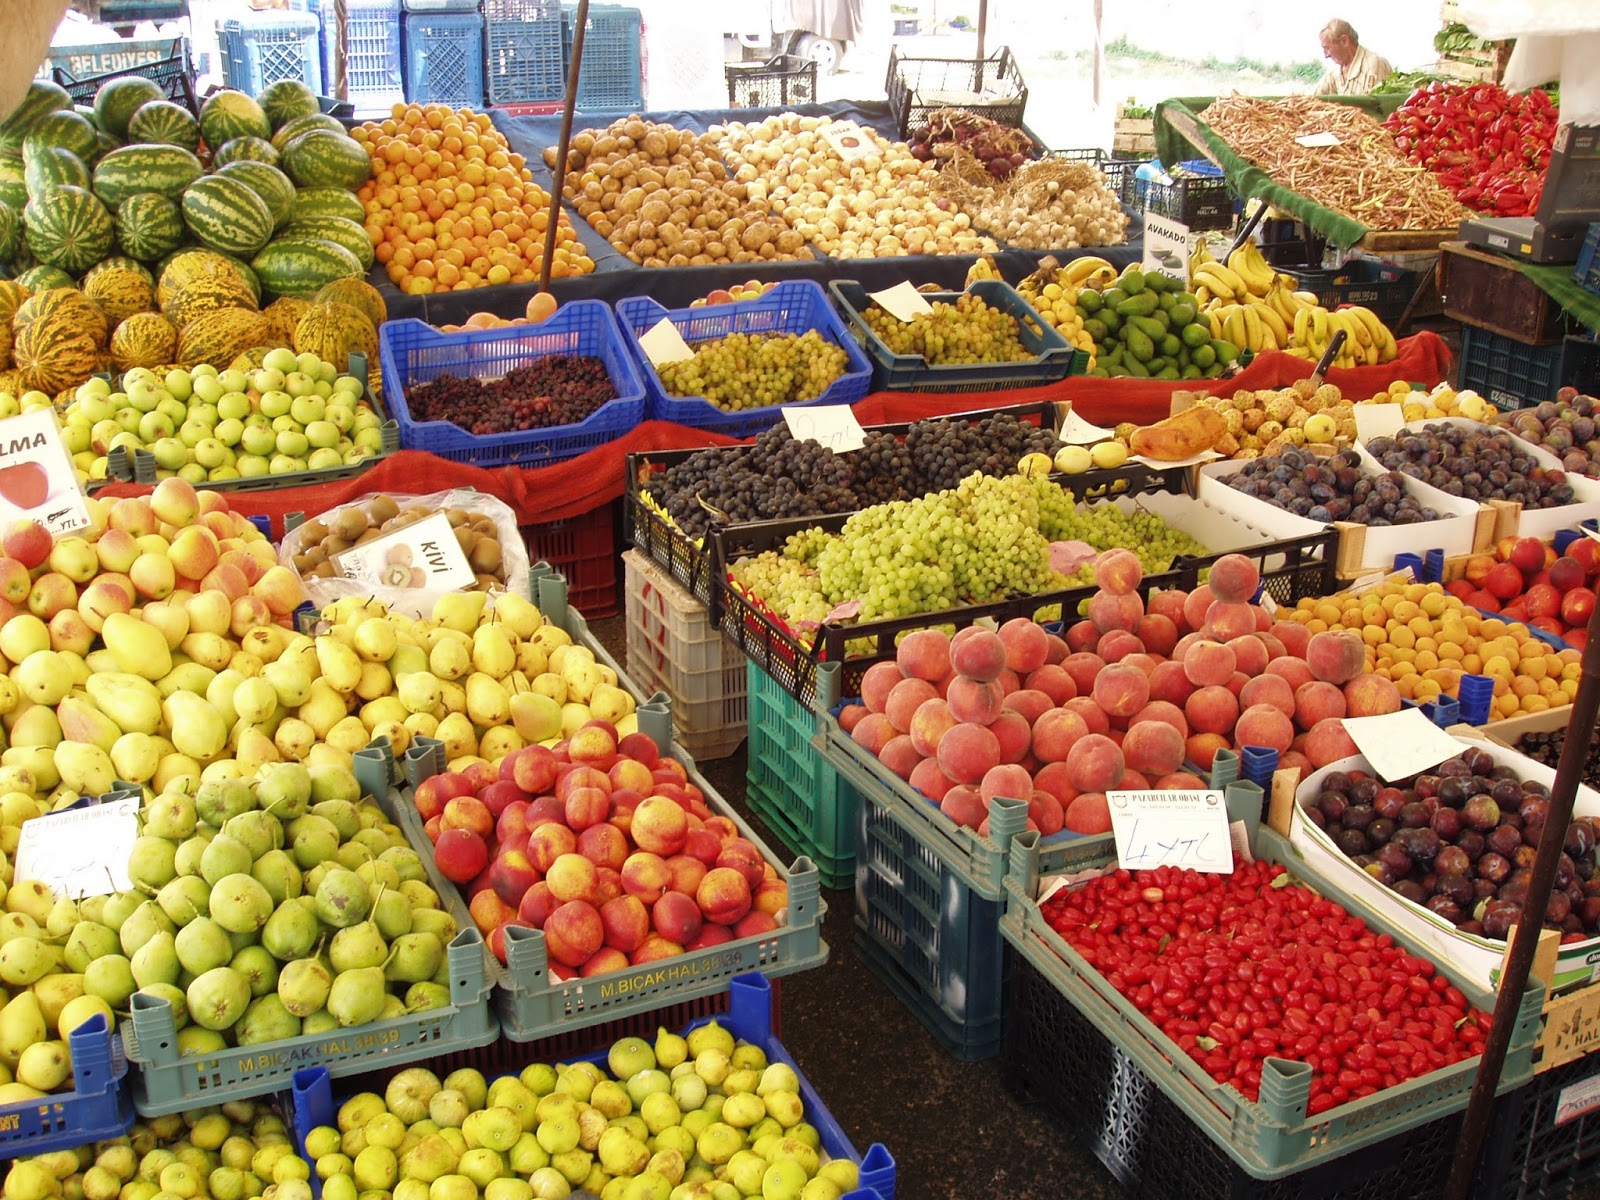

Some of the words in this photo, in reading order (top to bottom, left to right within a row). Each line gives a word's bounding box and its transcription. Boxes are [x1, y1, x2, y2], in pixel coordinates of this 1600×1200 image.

[1147, 223, 1186, 244] AVAKADO
[668, 961, 701, 981] HAL
[1574, 1027, 1600, 1047] HAL
[315, 1041, 351, 1059] HAL
